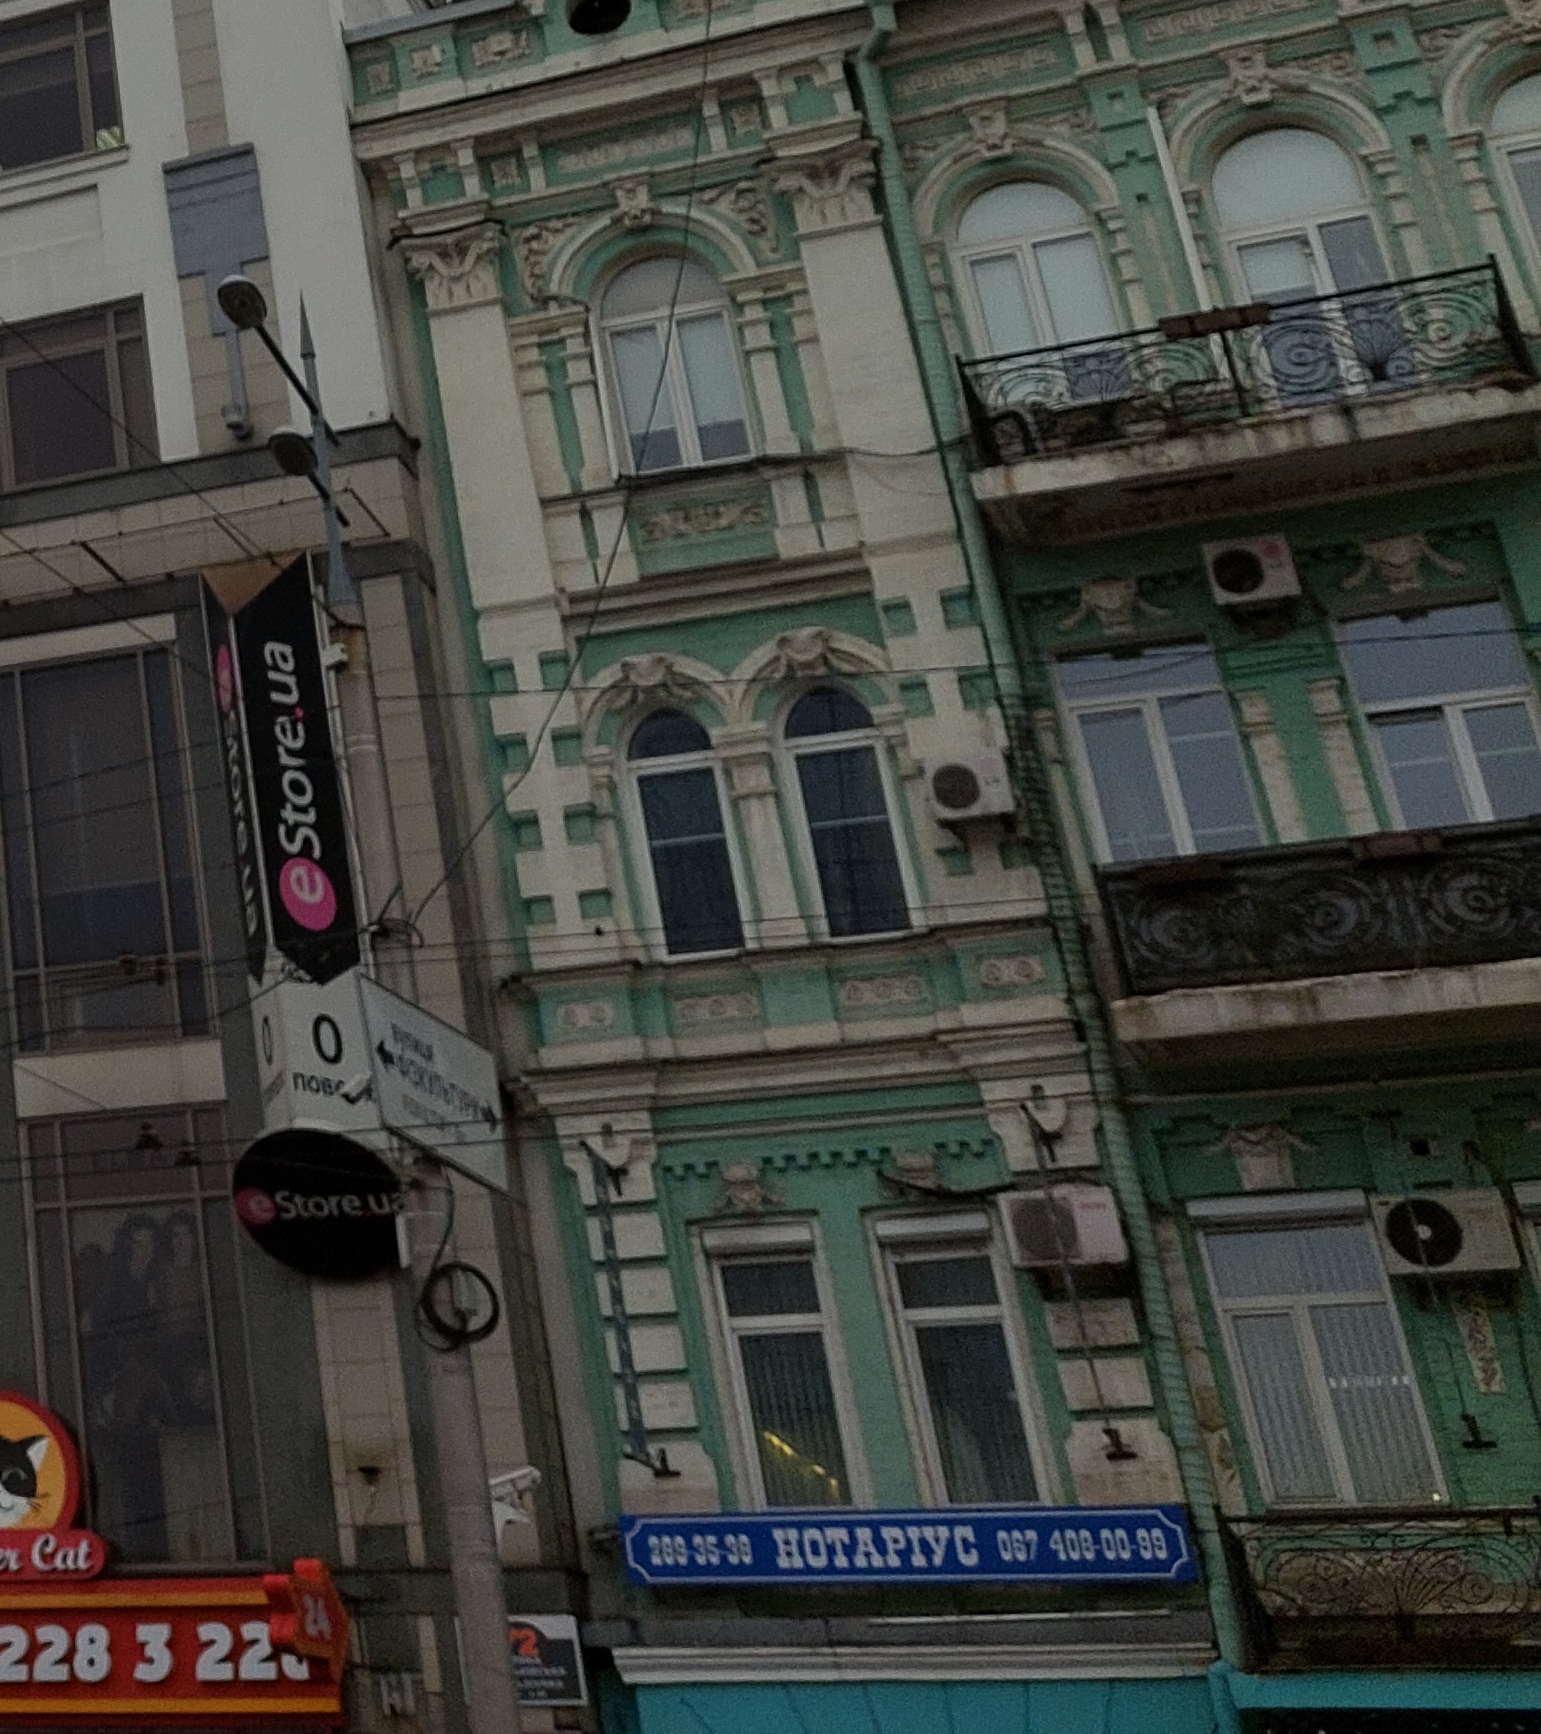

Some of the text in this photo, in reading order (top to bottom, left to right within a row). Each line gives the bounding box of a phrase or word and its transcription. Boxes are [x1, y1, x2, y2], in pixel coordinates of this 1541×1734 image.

[263, 640, 325, 904] eStore.ua
[30, 1533, 94, 1574] Cat
[771, 1525, 980, 1570] НОТАРІУС
[996, 1528, 1040, 1563] 067
[133, 1622, 175, 1684] 3
